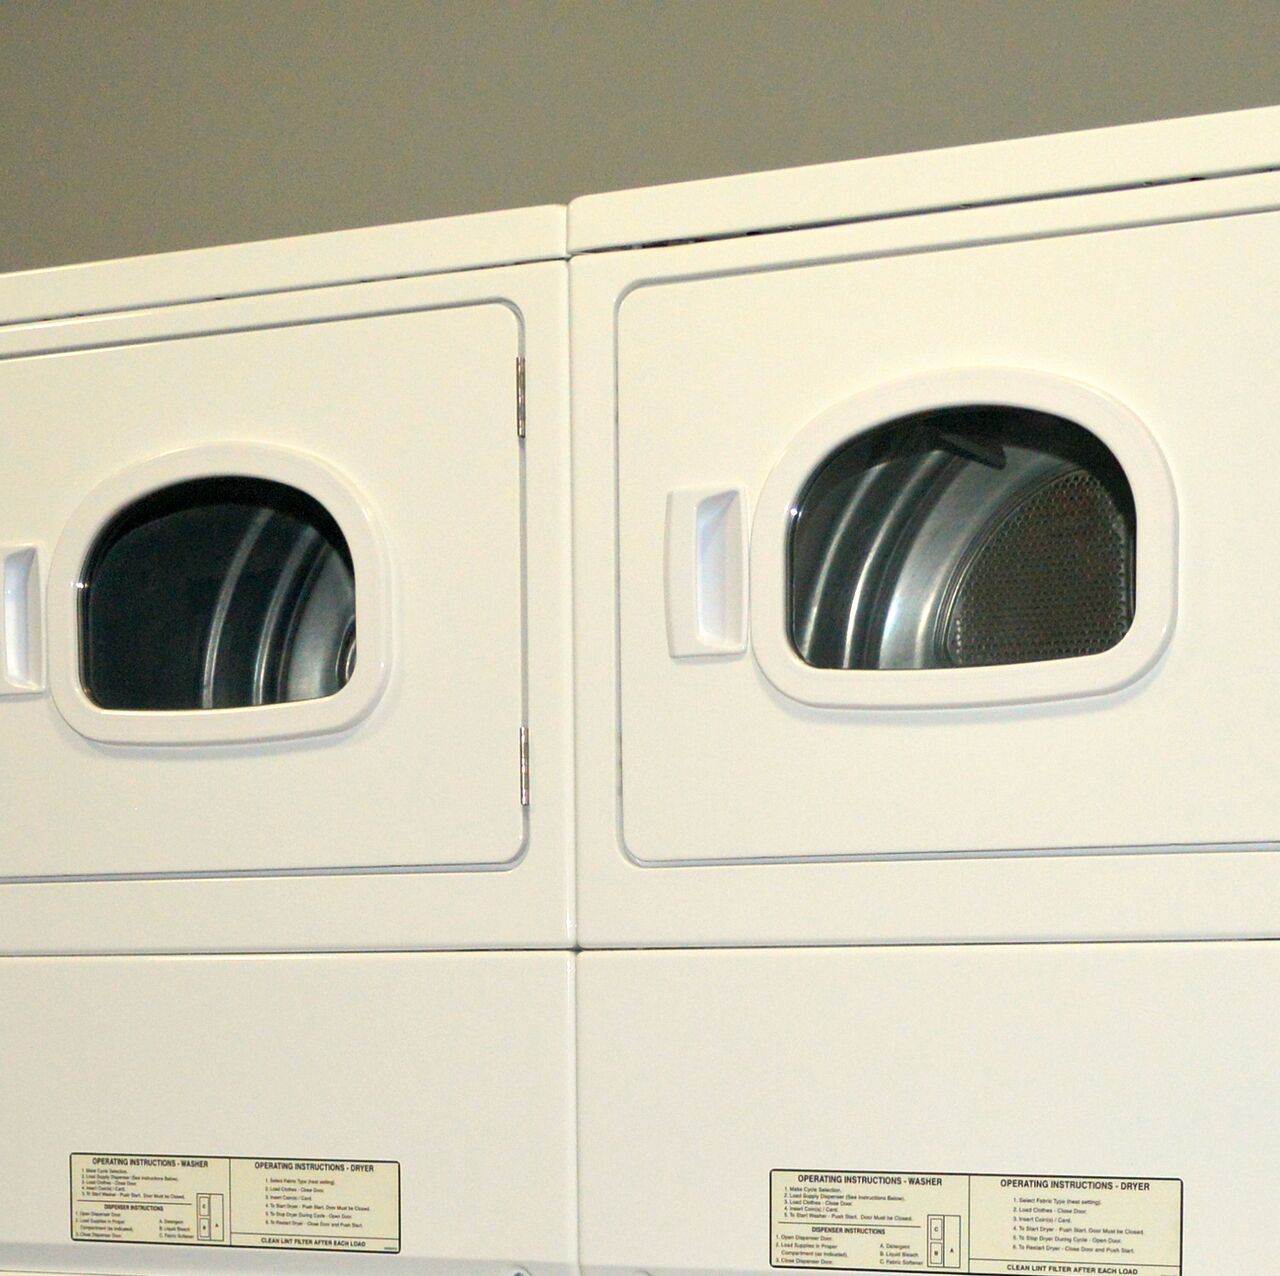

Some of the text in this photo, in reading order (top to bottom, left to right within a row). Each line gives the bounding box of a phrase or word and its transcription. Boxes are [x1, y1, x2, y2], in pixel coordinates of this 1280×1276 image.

[92, 1158, 128, 1166] OPERATING
[130, 1159, 176, 1167] INSTRUCTIONS
[181, 1160, 208, 1168] WASHER
[255, 1161, 293, 1170] OPERATING
[295, 1163, 345, 1171] INSTRUCTIONS
[351, 1164, 374, 1172] DRYER
[798, 1175, 842, 1183] OPERATING
[844, 1176, 902, 1184] INSTRUCTIONS
[909, 1177, 942, 1186] WASHER
[1000, 1179, 1048, 1188] OPERATING
[1051, 1180, 1113, 1190] INSTRUCTIONS
[1121, 1182, 1150, 1190] DRYER
